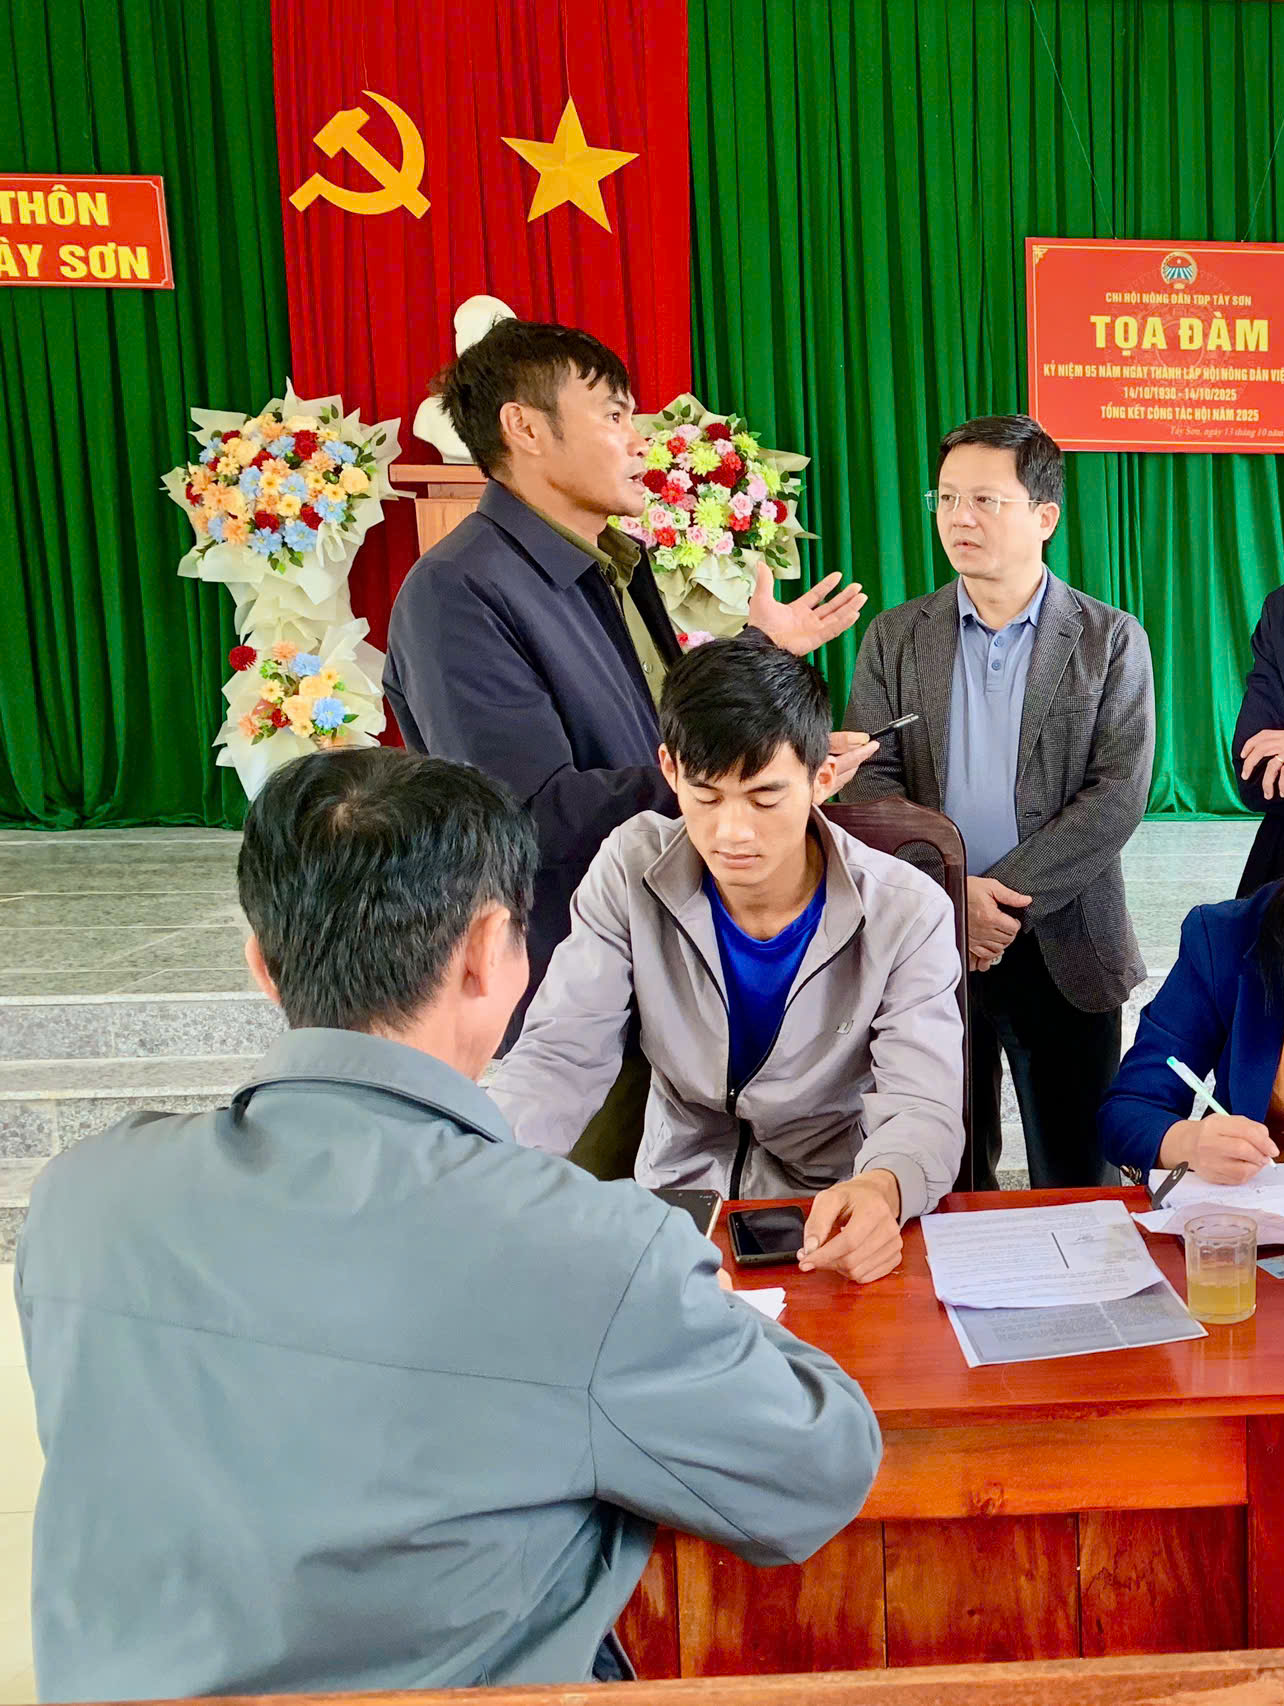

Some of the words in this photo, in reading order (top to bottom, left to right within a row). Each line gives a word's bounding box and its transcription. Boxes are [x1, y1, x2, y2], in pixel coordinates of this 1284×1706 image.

[0, 184, 109, 226] THÔN
[58, 242, 150, 279] SƠN
[1105, 292, 1122, 303] CHI
[1124, 291, 1140, 304] HỘI
[1142, 291, 1169, 304] NÔNG
[1171, 293, 1191, 304] DÂN
[1213, 293, 1230, 305] TÂY
[1232, 295, 1252, 306] SƠN
[1090, 315, 1167, 356] TỌA
[1178, 311, 1268, 352] ĐÀM
[1057, 362, 1083, 379] NIỆM
[1085, 365, 1097, 377] 95
[1098, 363, 1121, 378] NĂM
[1203, 366, 1219, 382] HỘI
[1221, 366, 1248, 381] NÔNG
[1249, 366, 1269, 382] DÂN
[1124, 386, 1177, 400] 14/10/1930
[1184, 387, 1237, 401] 14/10/2025
[1128, 403, 1145, 419] KẾT
[1147, 405, 1173, 420] CÔNG
[1175, 406, 1193, 420] TÁC
[1194, 406, 1210, 423] HỘI
[1212, 407, 1234, 421] NĂM
[1235, 409, 1259, 422] 2025
